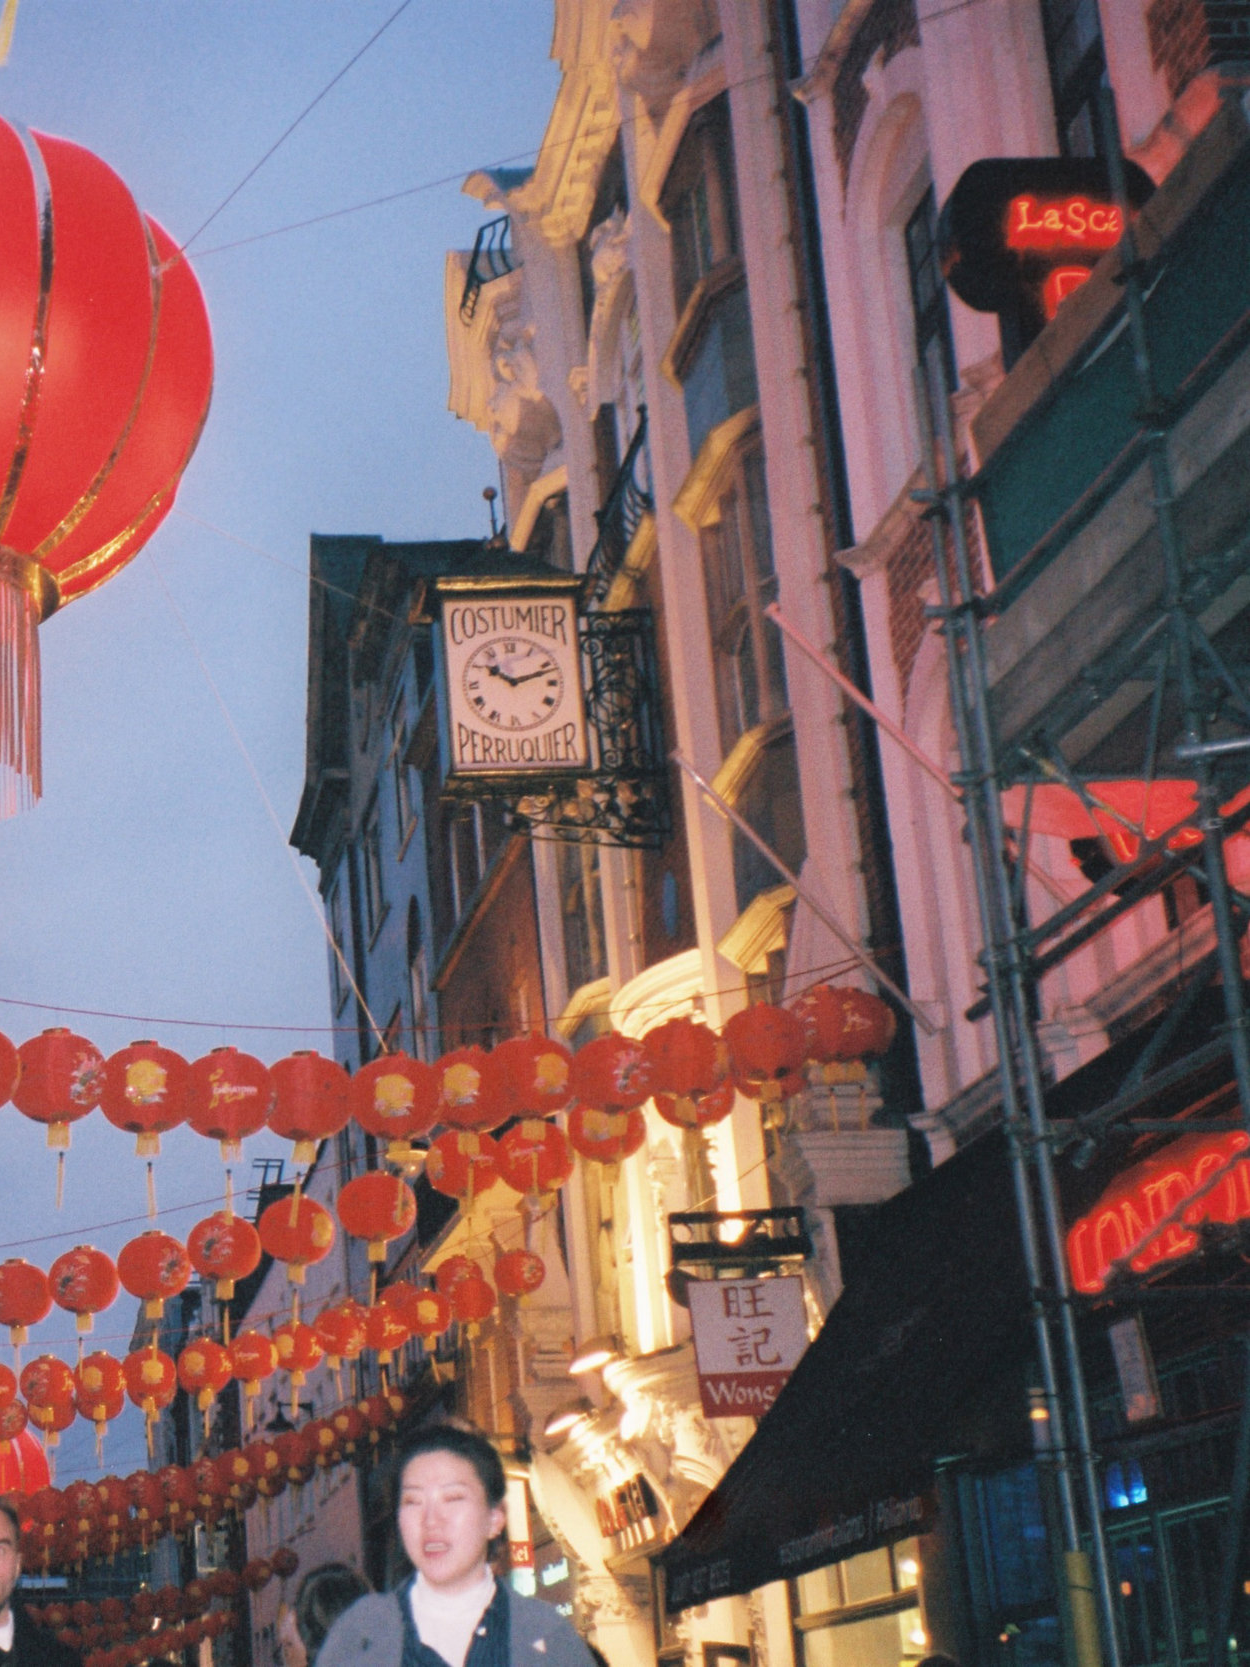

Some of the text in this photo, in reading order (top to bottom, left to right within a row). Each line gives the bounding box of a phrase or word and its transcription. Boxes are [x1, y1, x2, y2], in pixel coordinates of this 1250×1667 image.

[450, 605, 568, 645] COSTUMIER
[457, 722, 579, 764] PERRUQUIER
[722, 1283, 783, 1366] 旺記
